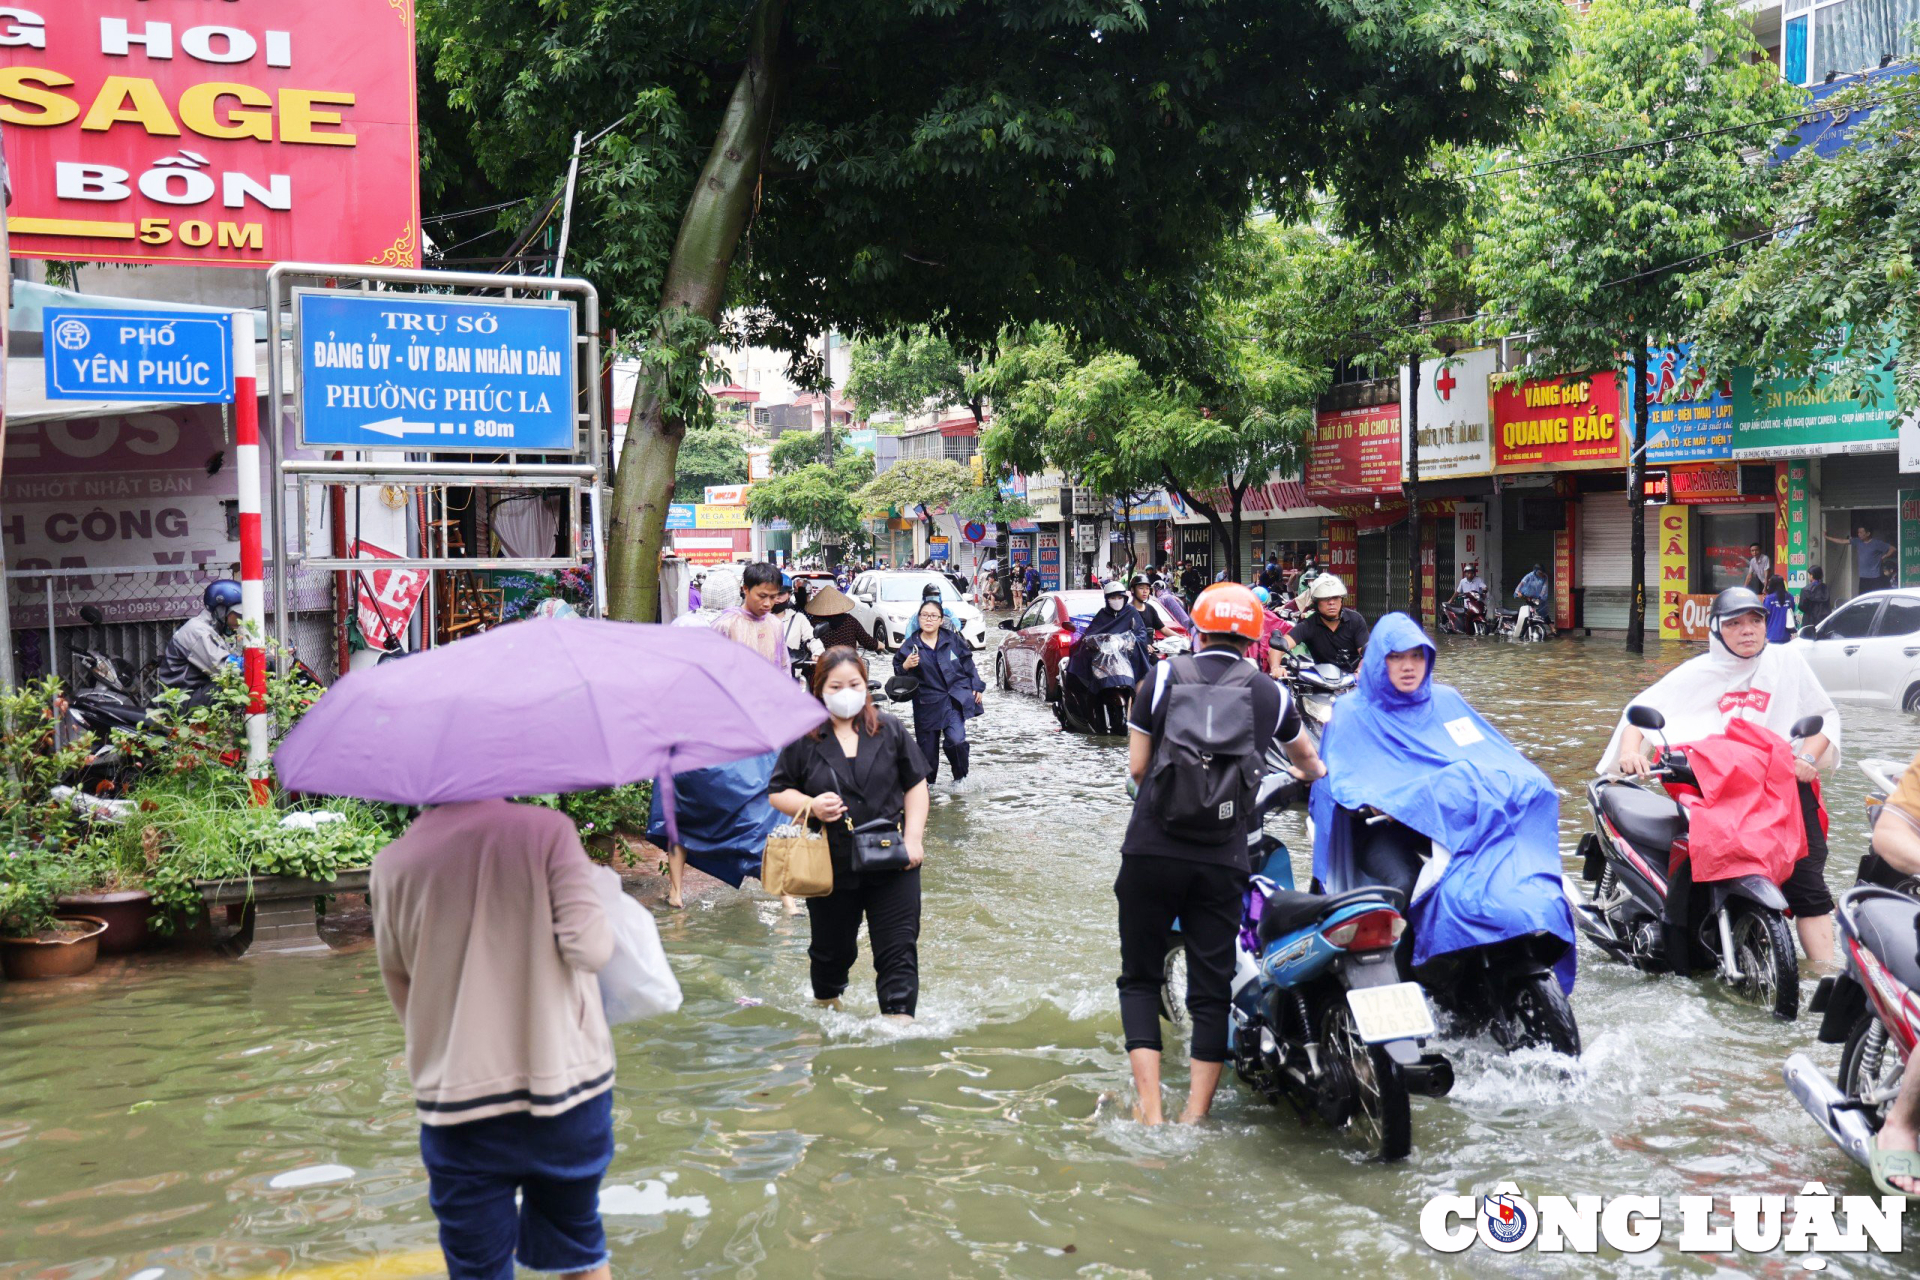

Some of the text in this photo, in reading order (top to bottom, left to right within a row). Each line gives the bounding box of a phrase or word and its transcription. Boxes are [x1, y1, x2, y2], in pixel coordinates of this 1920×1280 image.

[56, 149, 291, 210] BỒN
[139, 218, 263, 249] 50M
[119, 324, 176, 346] PHỐ
[381, 312, 499, 336] TRỤ SỞ
[314, 331, 561, 376] ĐẢNG ỦY ỦY BAN NHÂN DÂN
[73, 353, 210, 386] YÊN PHÚC
[326, 384, 552, 413] PHƯỜNG PHÚC LA
[1524, 381, 1590, 408] VÀNG BẠC
[1652, 410, 1660, 423] XE
[1661, 408, 1674, 423] MÁY
[1678, 406, 1692, 423] ĐIỆN
[1693, 406, 1711, 421] THOẠI
[474, 419, 514, 438] 80m
[1320, 421, 1336, 441] THẤT
[1343, 421, 1353, 439] TÔ
[1358, 418, 1369, 437] ĐỒ
[1370, 419, 1388, 435] CHƠI
[1390, 418, 1400, 433] XE
[1503, 405, 1615, 450] QUANG BẮC
[16, 474, 192, 499] NHỚT NHẬT BẢN
[1672, 472, 1692, 493] MUA
[1692, 469, 1710, 491] BÁN
[1710, 468, 1729, 490] CÁC
[45, 507, 189, 543] CÔNG
[1459, 506, 1483, 530] THIẾT
[1011, 540, 1028, 548] 37A
[1040, 538, 1057, 547] 37A
[1184, 526, 1210, 543] KÍNH
[1466, 534, 1475, 556] BỊ
[1185, 549, 1208, 567] MẮT
[1345, 549, 1355, 564] XE
[1663, 516, 1687, 580] CẦM
